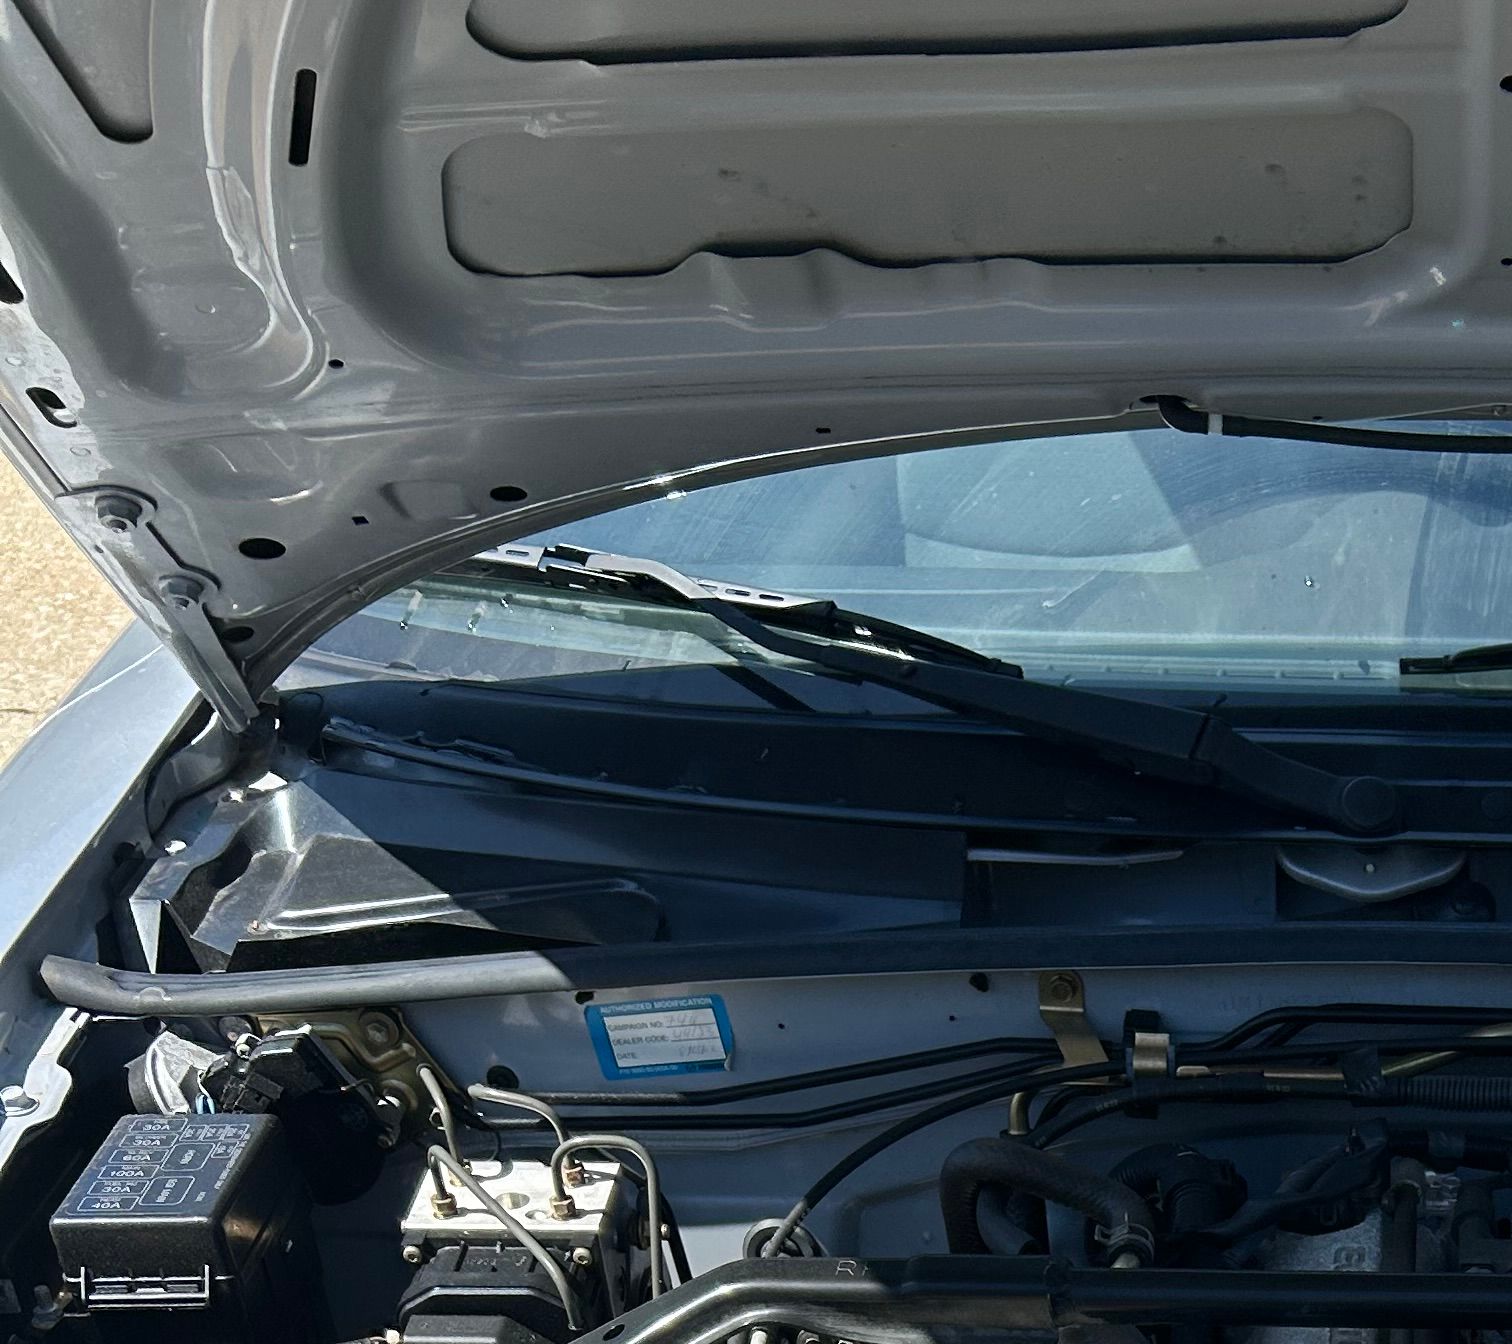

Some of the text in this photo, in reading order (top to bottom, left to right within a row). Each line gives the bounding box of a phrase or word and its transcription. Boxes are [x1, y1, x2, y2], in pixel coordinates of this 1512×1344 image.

[600, 997, 712, 1014] AUTHORIZED MODIFICATION
[608, 1021, 648, 1031] CAMPAIGN
[612, 1037, 644, 1047] DEALER
[143, 1123, 170, 1131] 30A
